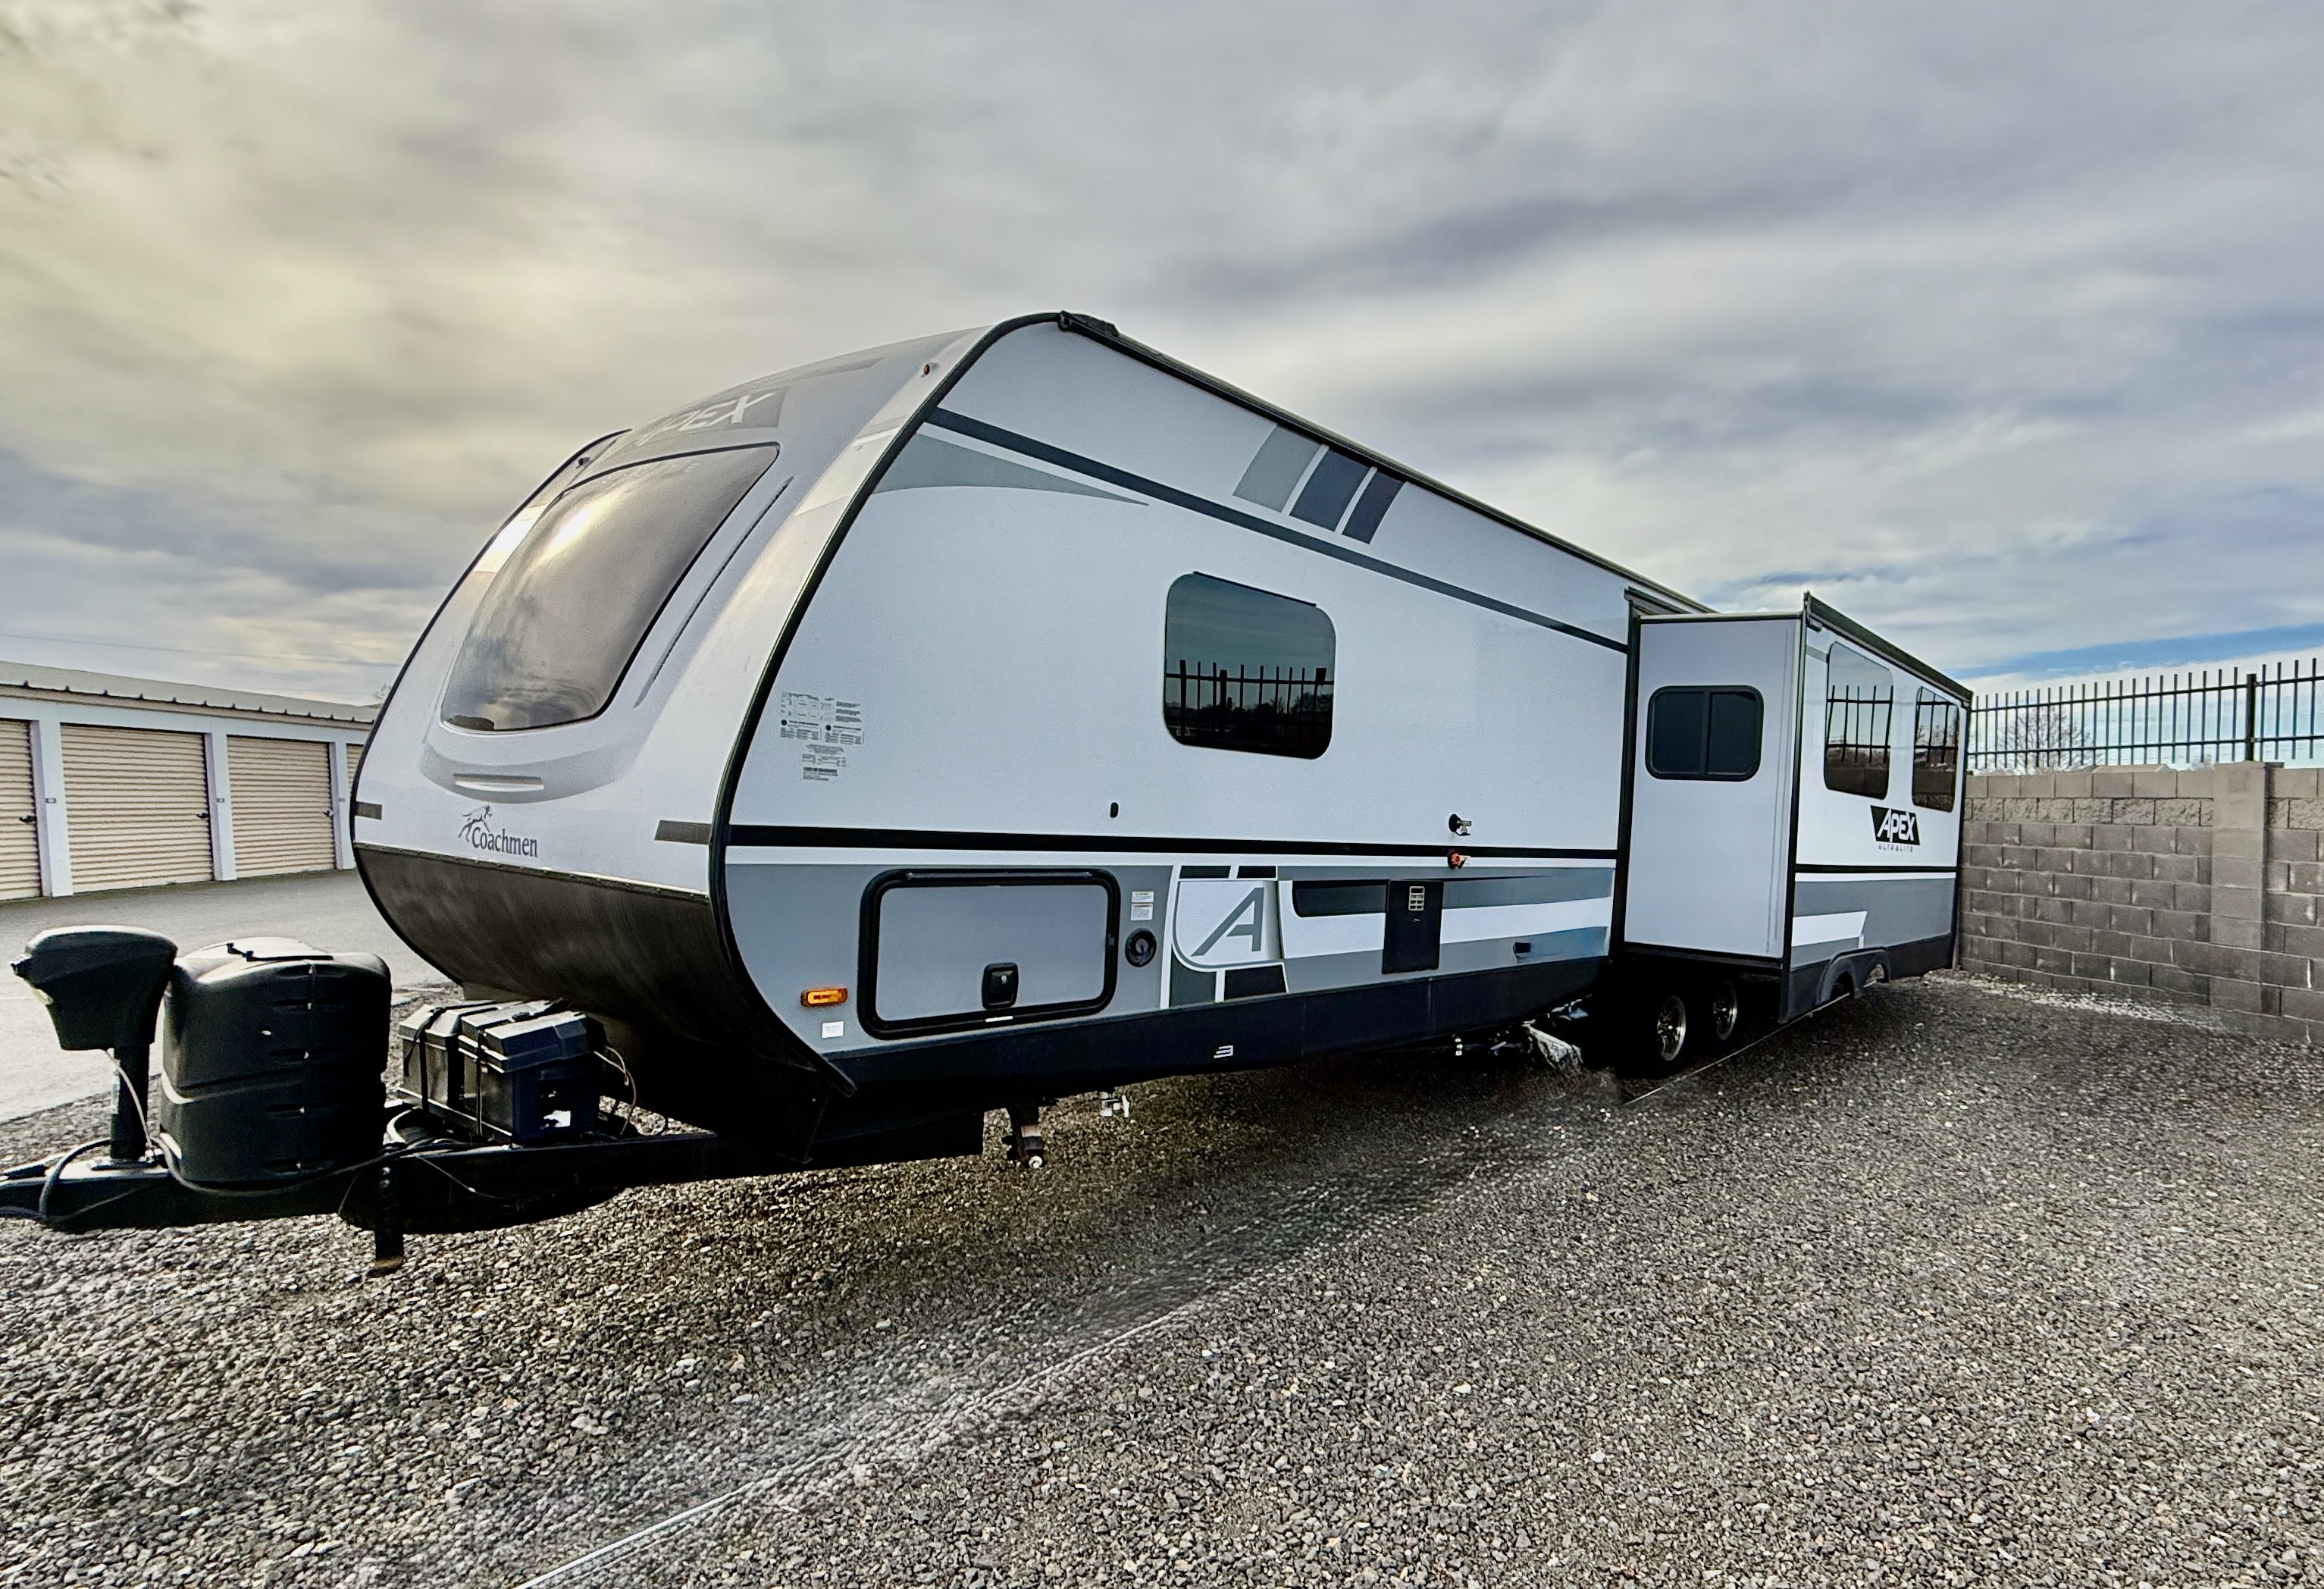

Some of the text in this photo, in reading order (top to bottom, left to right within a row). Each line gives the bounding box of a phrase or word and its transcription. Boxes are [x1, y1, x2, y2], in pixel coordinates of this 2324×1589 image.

[471, 826, 538, 857] Coachmen
[1877, 808, 1915, 843] APEX
[1878, 843, 1913, 853] ULTRALITE
[1190, 887, 1264, 957] A
